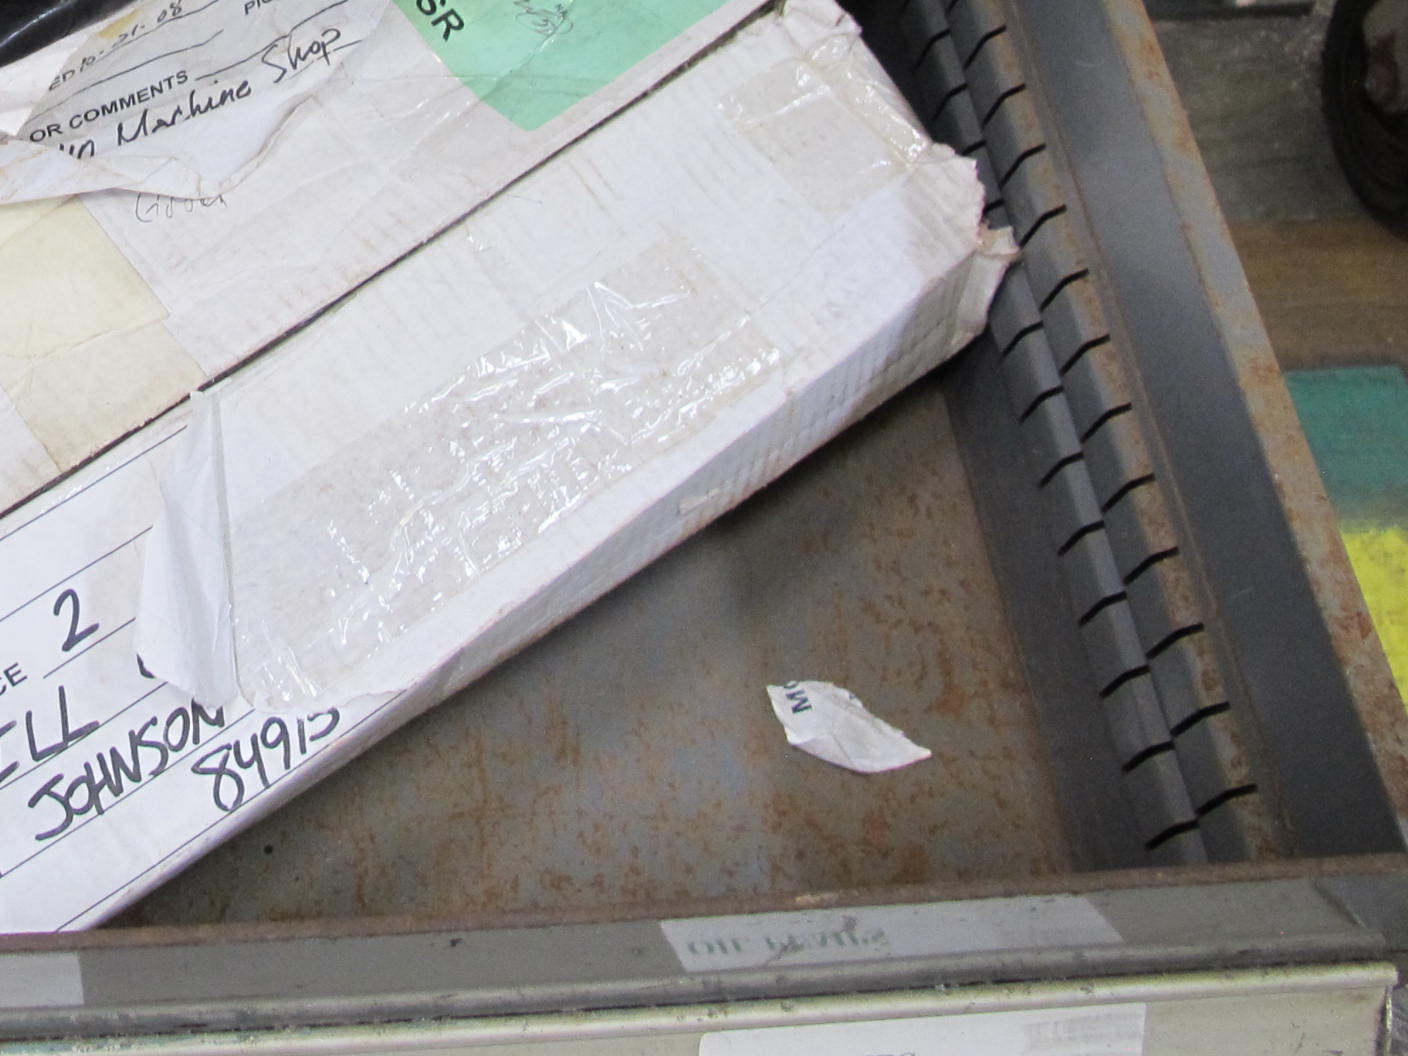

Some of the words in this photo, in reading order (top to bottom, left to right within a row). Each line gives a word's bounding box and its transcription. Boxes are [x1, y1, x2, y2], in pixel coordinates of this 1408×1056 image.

[29, 123, 64, 143] OR
[68, 69, 190, 130] COMMENTS
[51, 587, 100, 652] 2
[27, 696, 225, 841] JOHNSON
